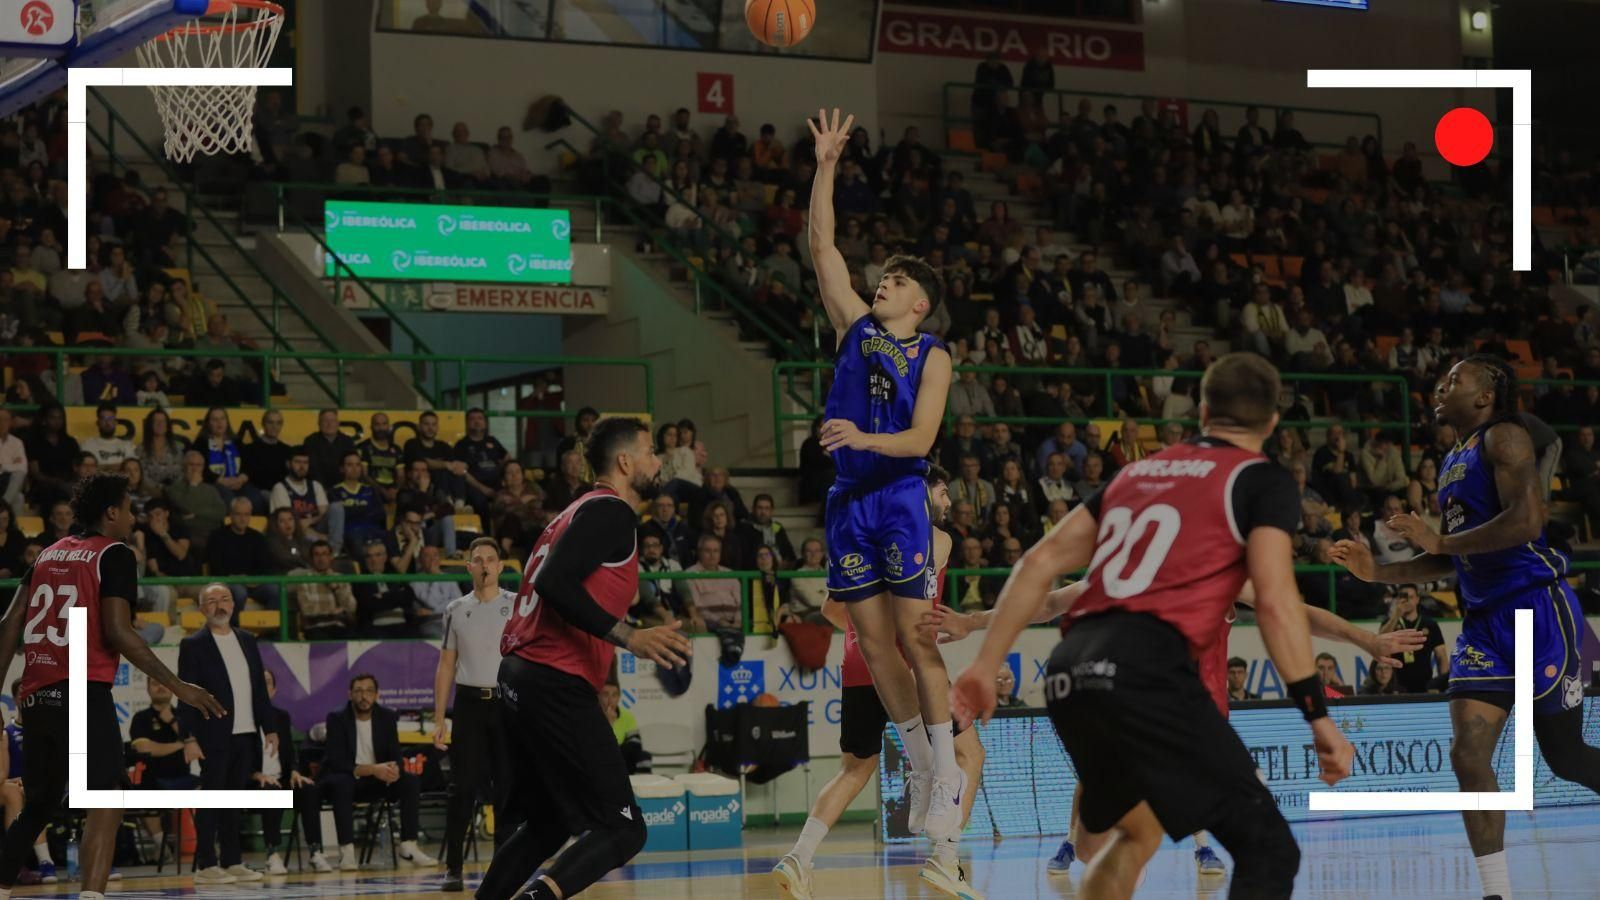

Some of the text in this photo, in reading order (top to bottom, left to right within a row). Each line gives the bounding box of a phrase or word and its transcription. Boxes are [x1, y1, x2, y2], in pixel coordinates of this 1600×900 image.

[886, 20, 1110, 60] GRADA RIO
[706, 79, 725, 108] 4
[456, 287, 595, 310] EMERXENCIA
[66, 549, 97, 564] KELLY
[1084, 503, 1181, 600] 20
[23, 583, 79, 647] 23
[778, 665, 842, 691] XUN
[1250, 745, 1296, 781] TEL
[1304, 739, 1442, 780] FNCISCO
